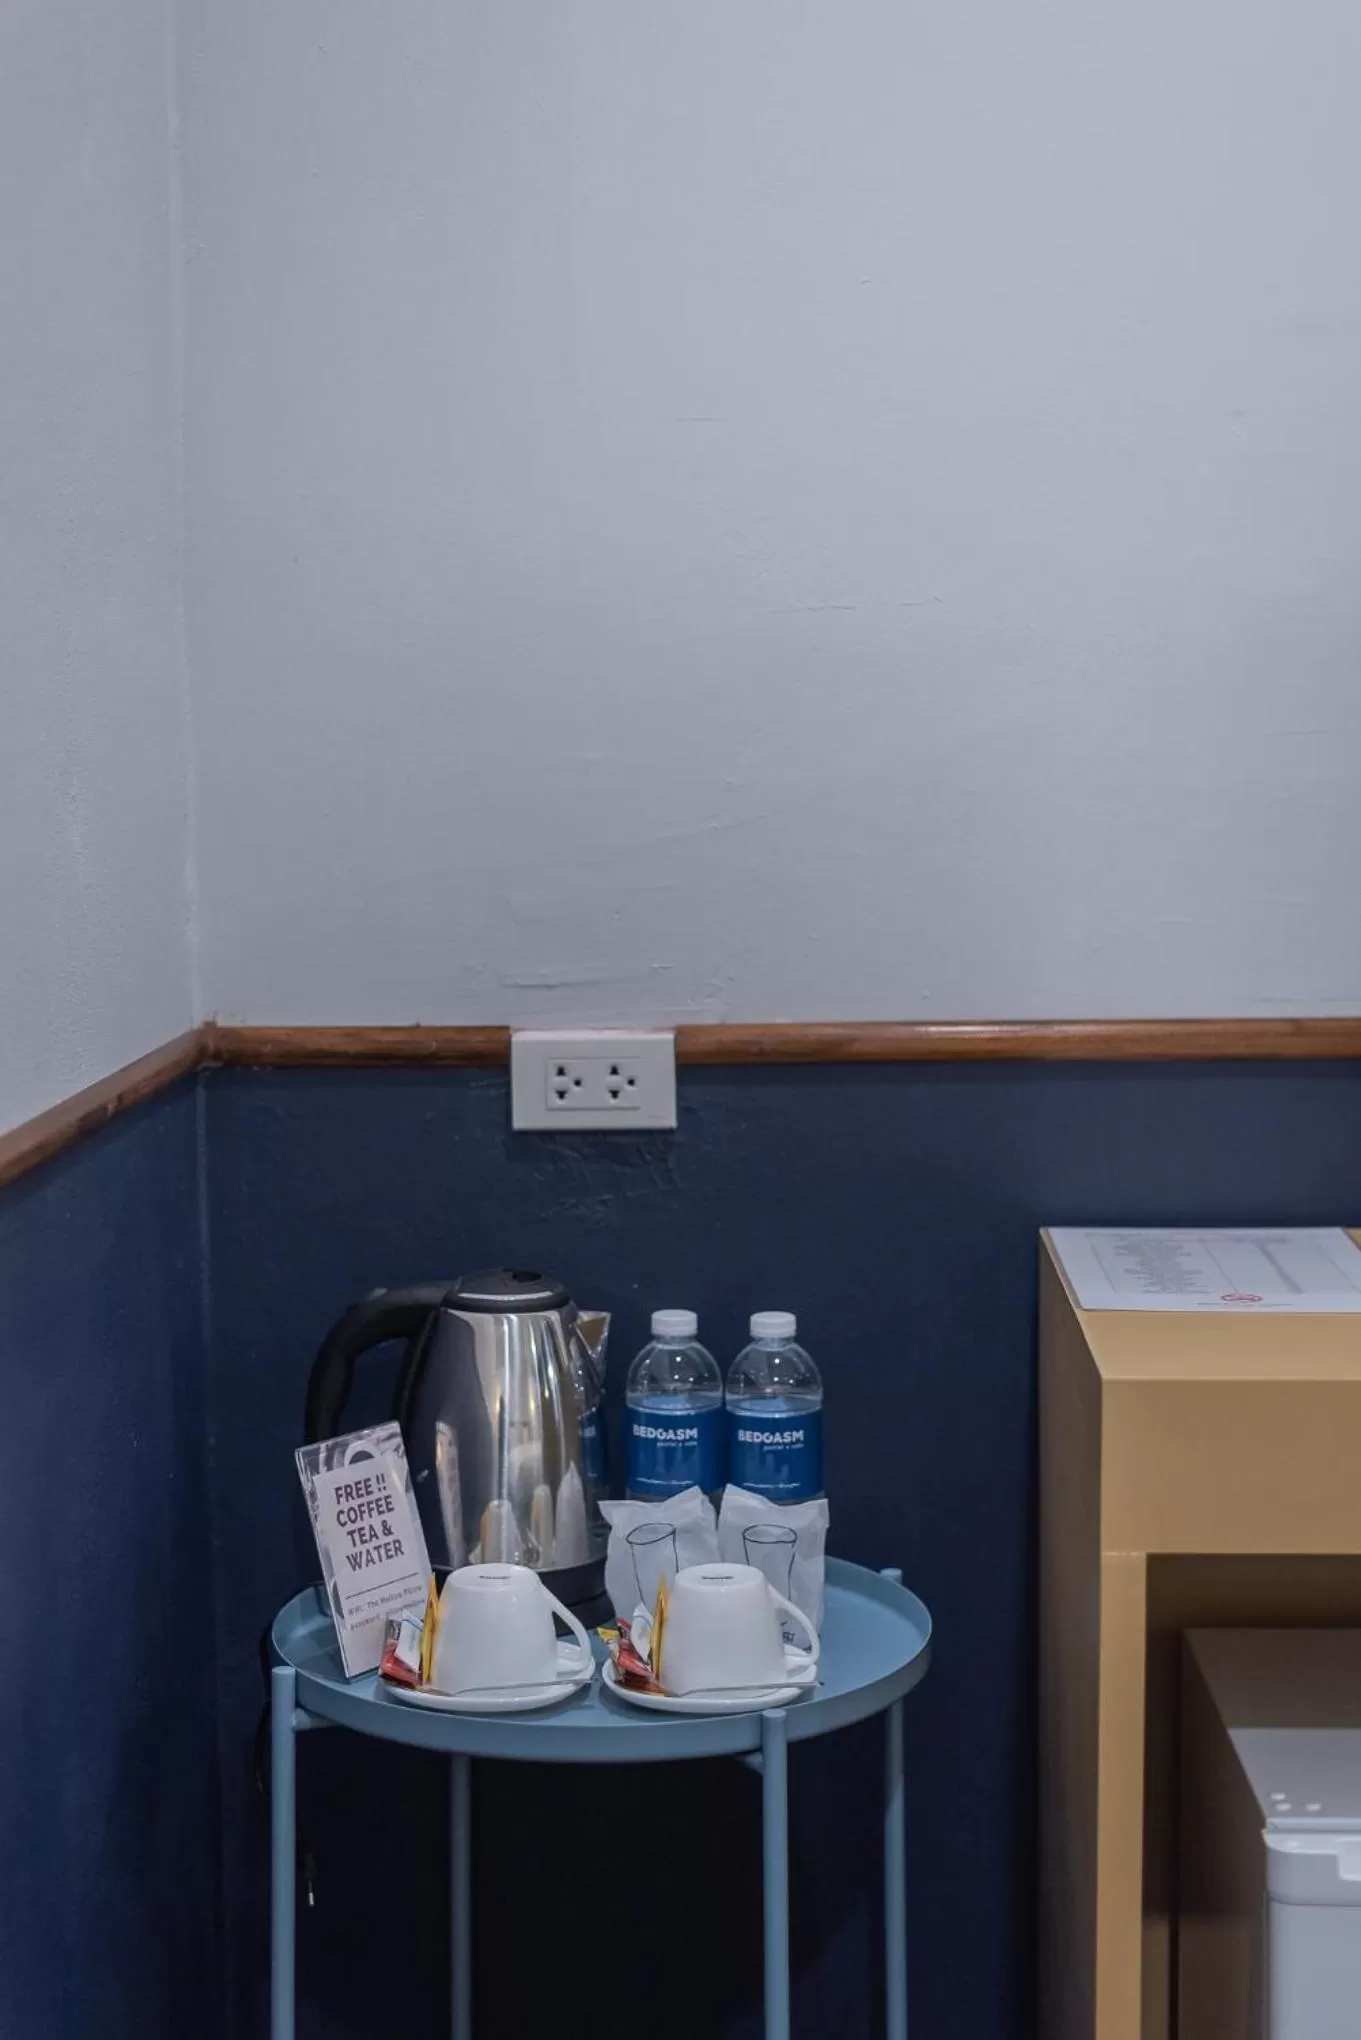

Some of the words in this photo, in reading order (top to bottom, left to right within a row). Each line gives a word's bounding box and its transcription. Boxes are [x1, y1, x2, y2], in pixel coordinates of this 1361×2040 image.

[632, 1424, 698, 1441] BEDGASM
[737, 1429, 804, 1444] BEDGASM
[335, 1477, 374, 1505] FREE
[336, 1494, 395, 1528] COFFEE
[346, 1523, 380, 1548] TEA
[381, 1519, 395, 1537] &
[345, 1538, 405, 1572] WATER
